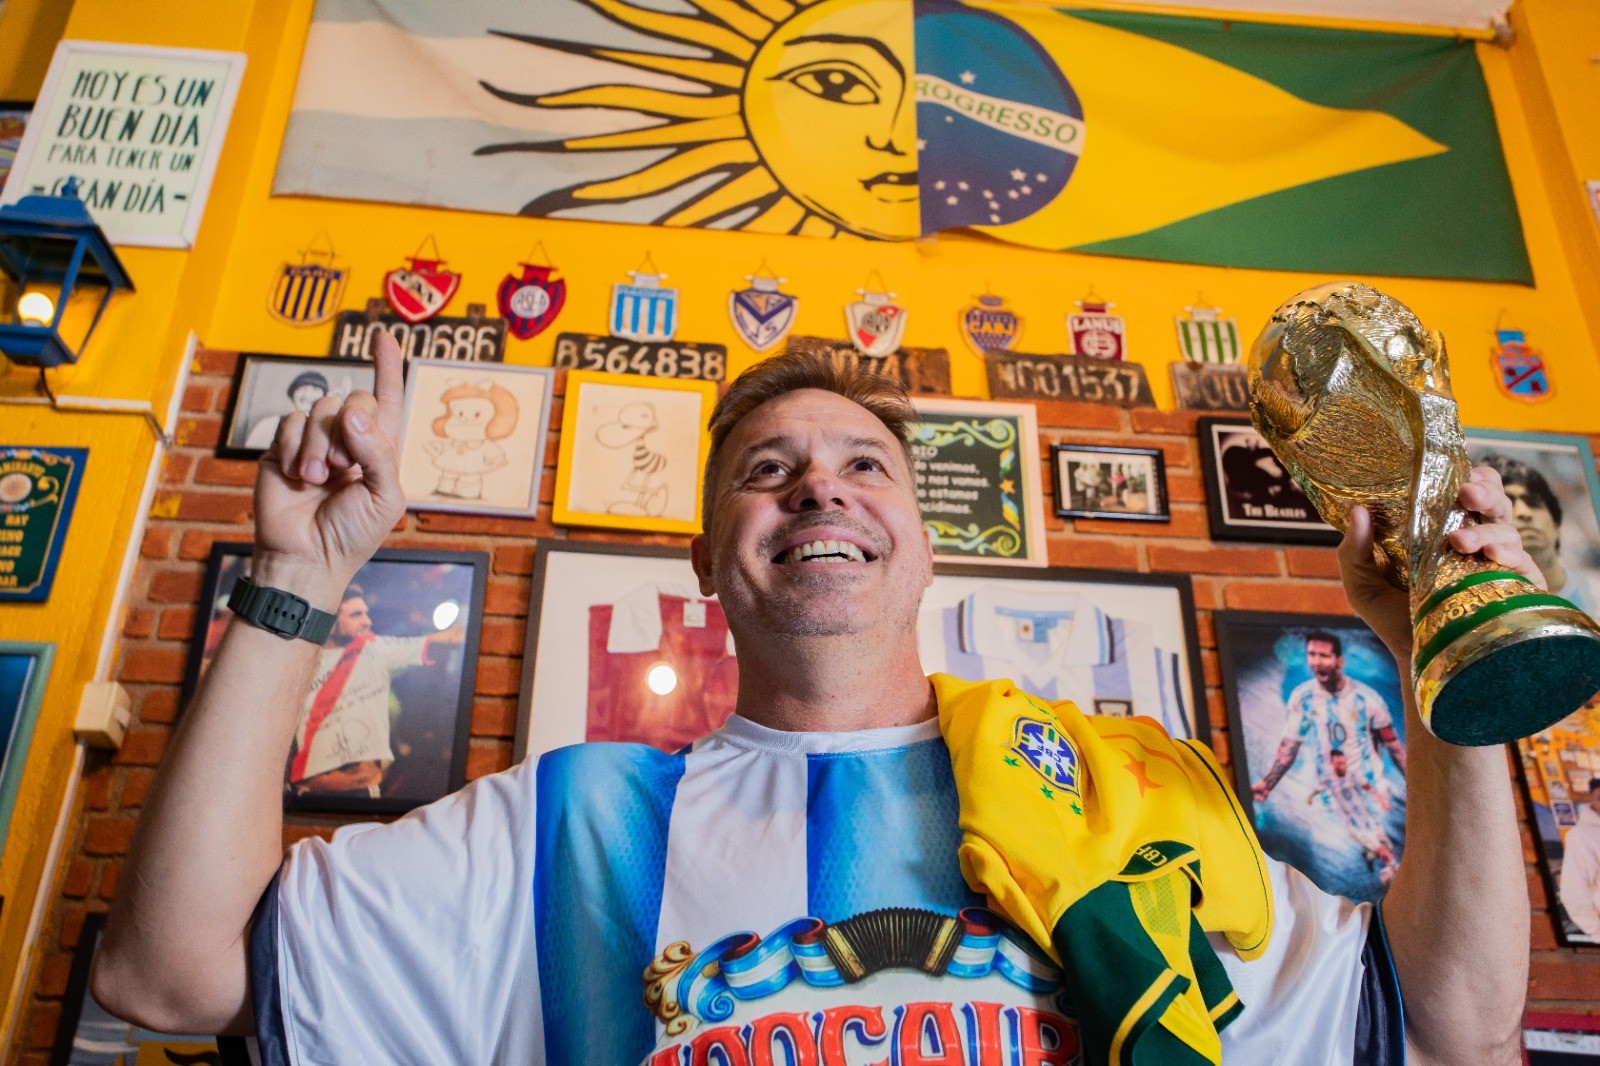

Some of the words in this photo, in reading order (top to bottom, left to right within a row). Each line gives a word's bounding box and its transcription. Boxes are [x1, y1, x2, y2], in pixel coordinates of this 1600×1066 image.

[71, 70, 130, 102] HOY
[130, 73, 168, 107] ES
[173, 77, 215, 108] UN
[56, 103, 145, 143] BUEN
[47, 143, 97, 164] PARA
[105, 147, 163, 171] TENER
[169, 152, 196, 172] UN
[556, 338, 726, 382] B564838
[1326, 722, 1347, 746] 10
